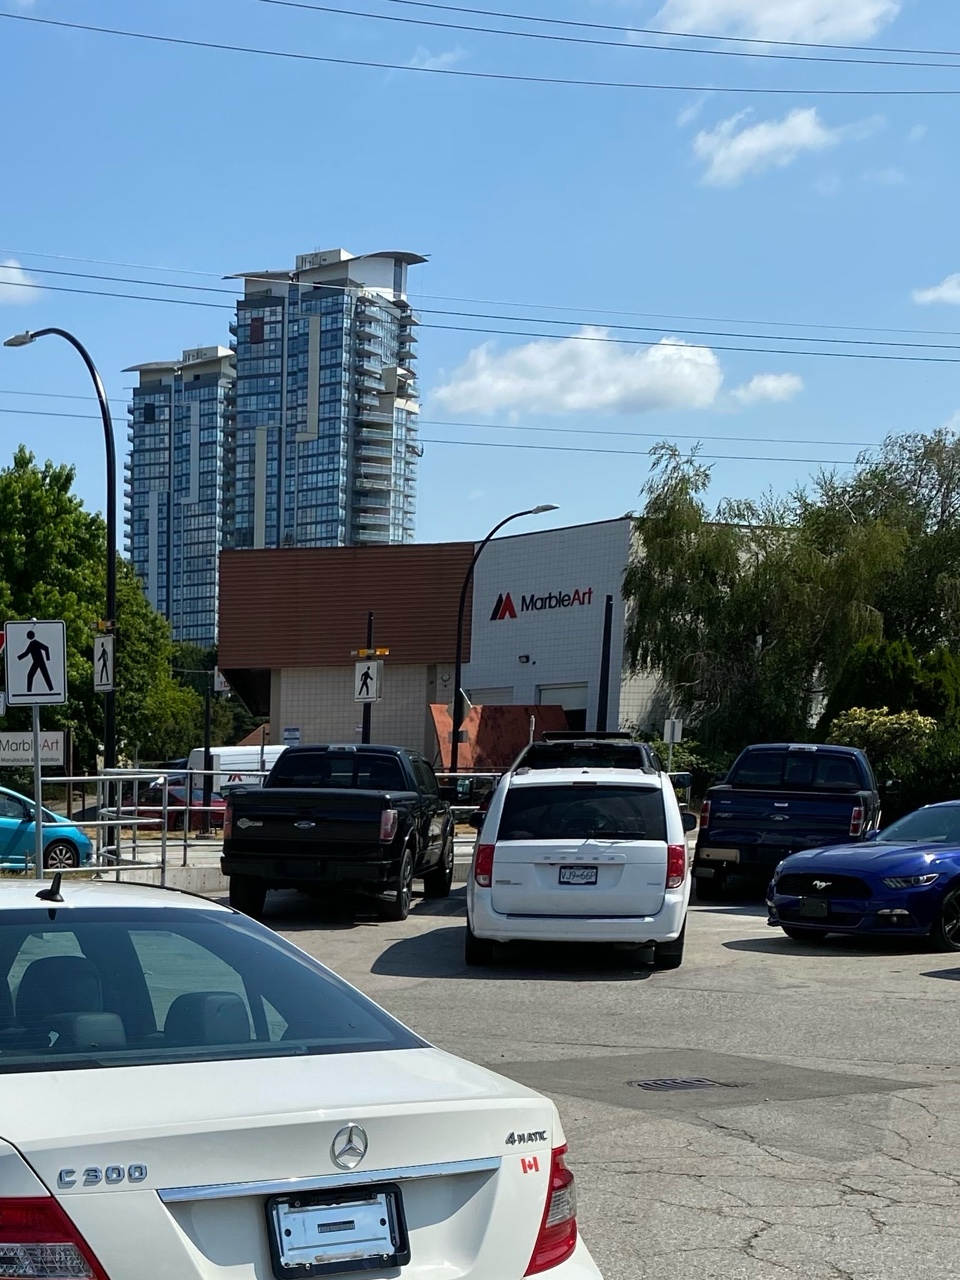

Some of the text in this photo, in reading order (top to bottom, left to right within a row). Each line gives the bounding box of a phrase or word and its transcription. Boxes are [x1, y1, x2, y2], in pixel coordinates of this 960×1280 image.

[521, 587, 593, 612] MarbleArt
[58, 1163, 147, 1187] C 300
